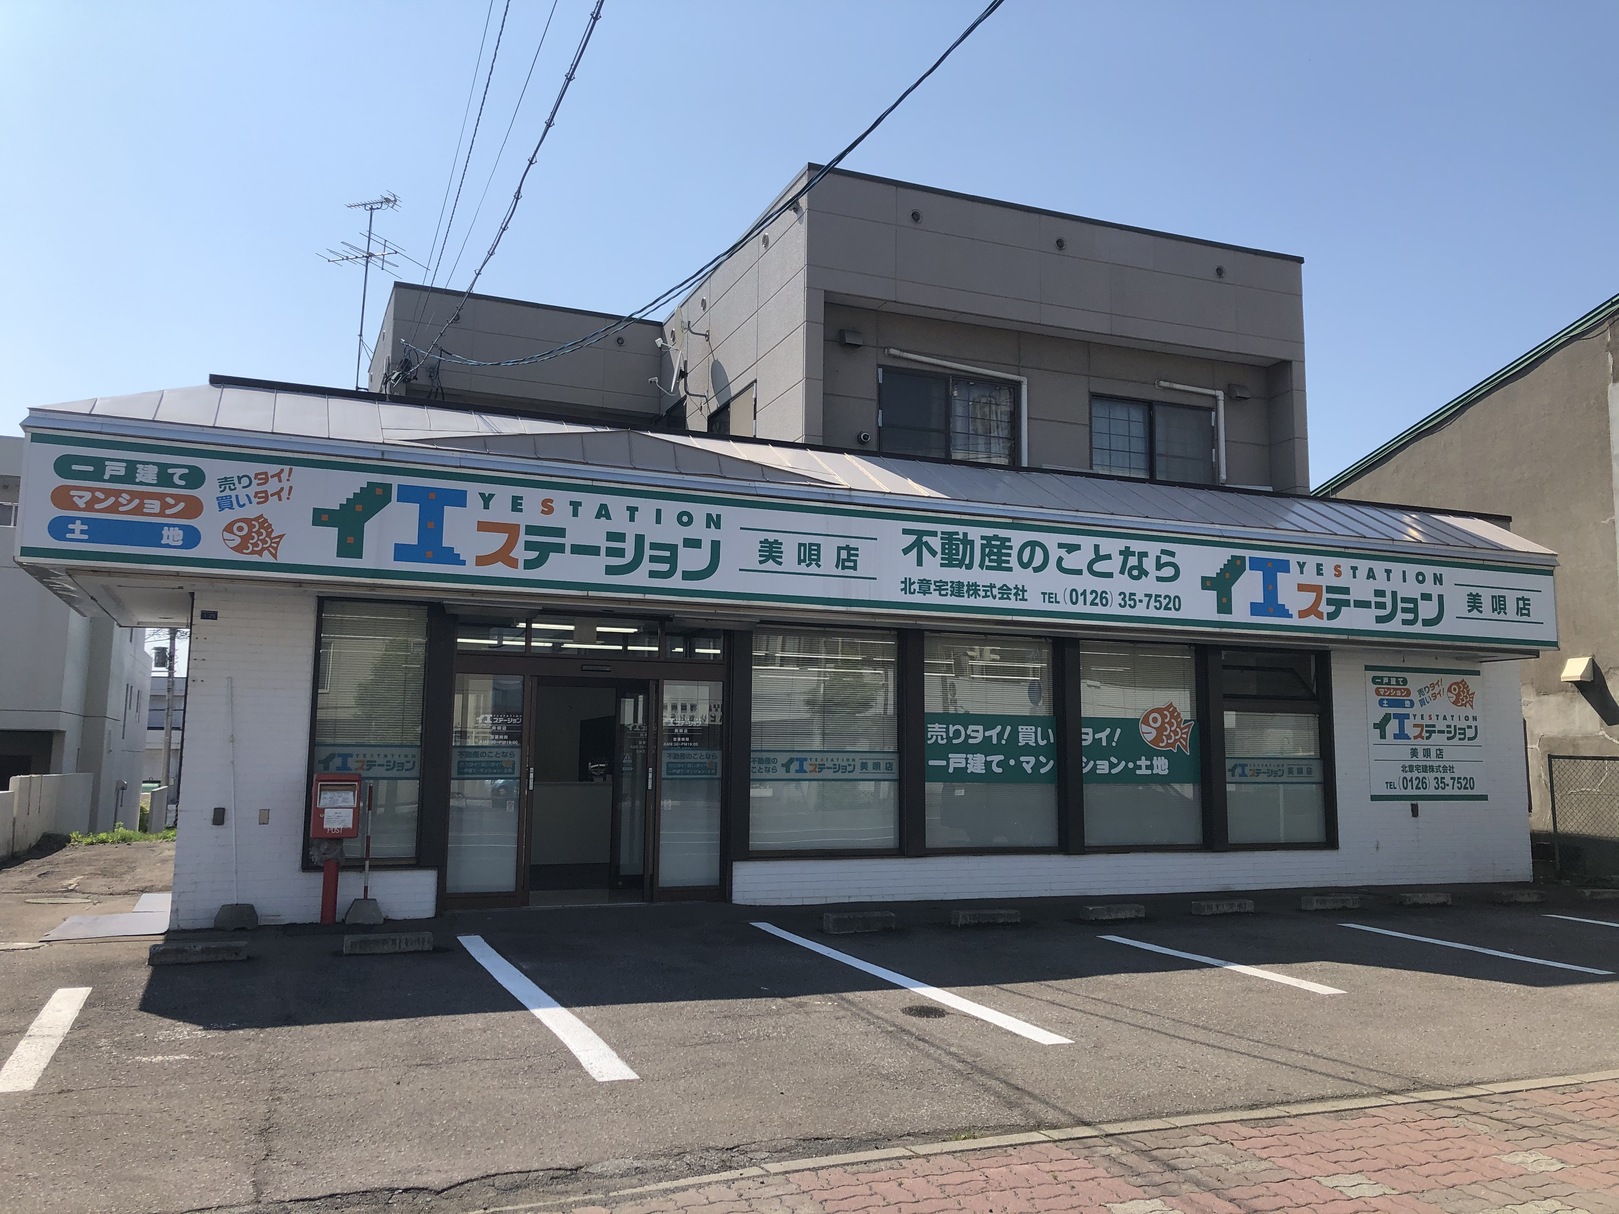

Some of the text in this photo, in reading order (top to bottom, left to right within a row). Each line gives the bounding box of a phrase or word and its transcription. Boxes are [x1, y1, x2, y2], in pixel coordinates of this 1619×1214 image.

[71, 460, 190, 486] 一戸建て
[216, 466, 294, 494] 売りタイ!
[69, 489, 186, 515] マンション
[215, 485, 294, 513] 買いタイ!
[478, 491, 722, 530] YESTATION
[65, 519, 184, 546] 土地
[758, 538, 861, 572] 美唄店
[901, 528, 1181, 583] 不動産のことなら
[1296, 560, 1444, 587] YESTATION
[900, 577, 1028, 603] 北章宅建株式会社
[1041, 586, 1182, 612] TEL (0126) 35-7520
[1466, 591, 1532, 619] 美唄店
[1379, 688, 1407, 696] マンション
[1412, 713, 1478, 722] YESTATION
[926, 722, 1012, 745] 売りタイ!
[1409, 747, 1444, 759] 美唄店
[1401, 764, 1455, 773] 北章宅建株式会社
[1385, 781, 1397, 790] TEL
